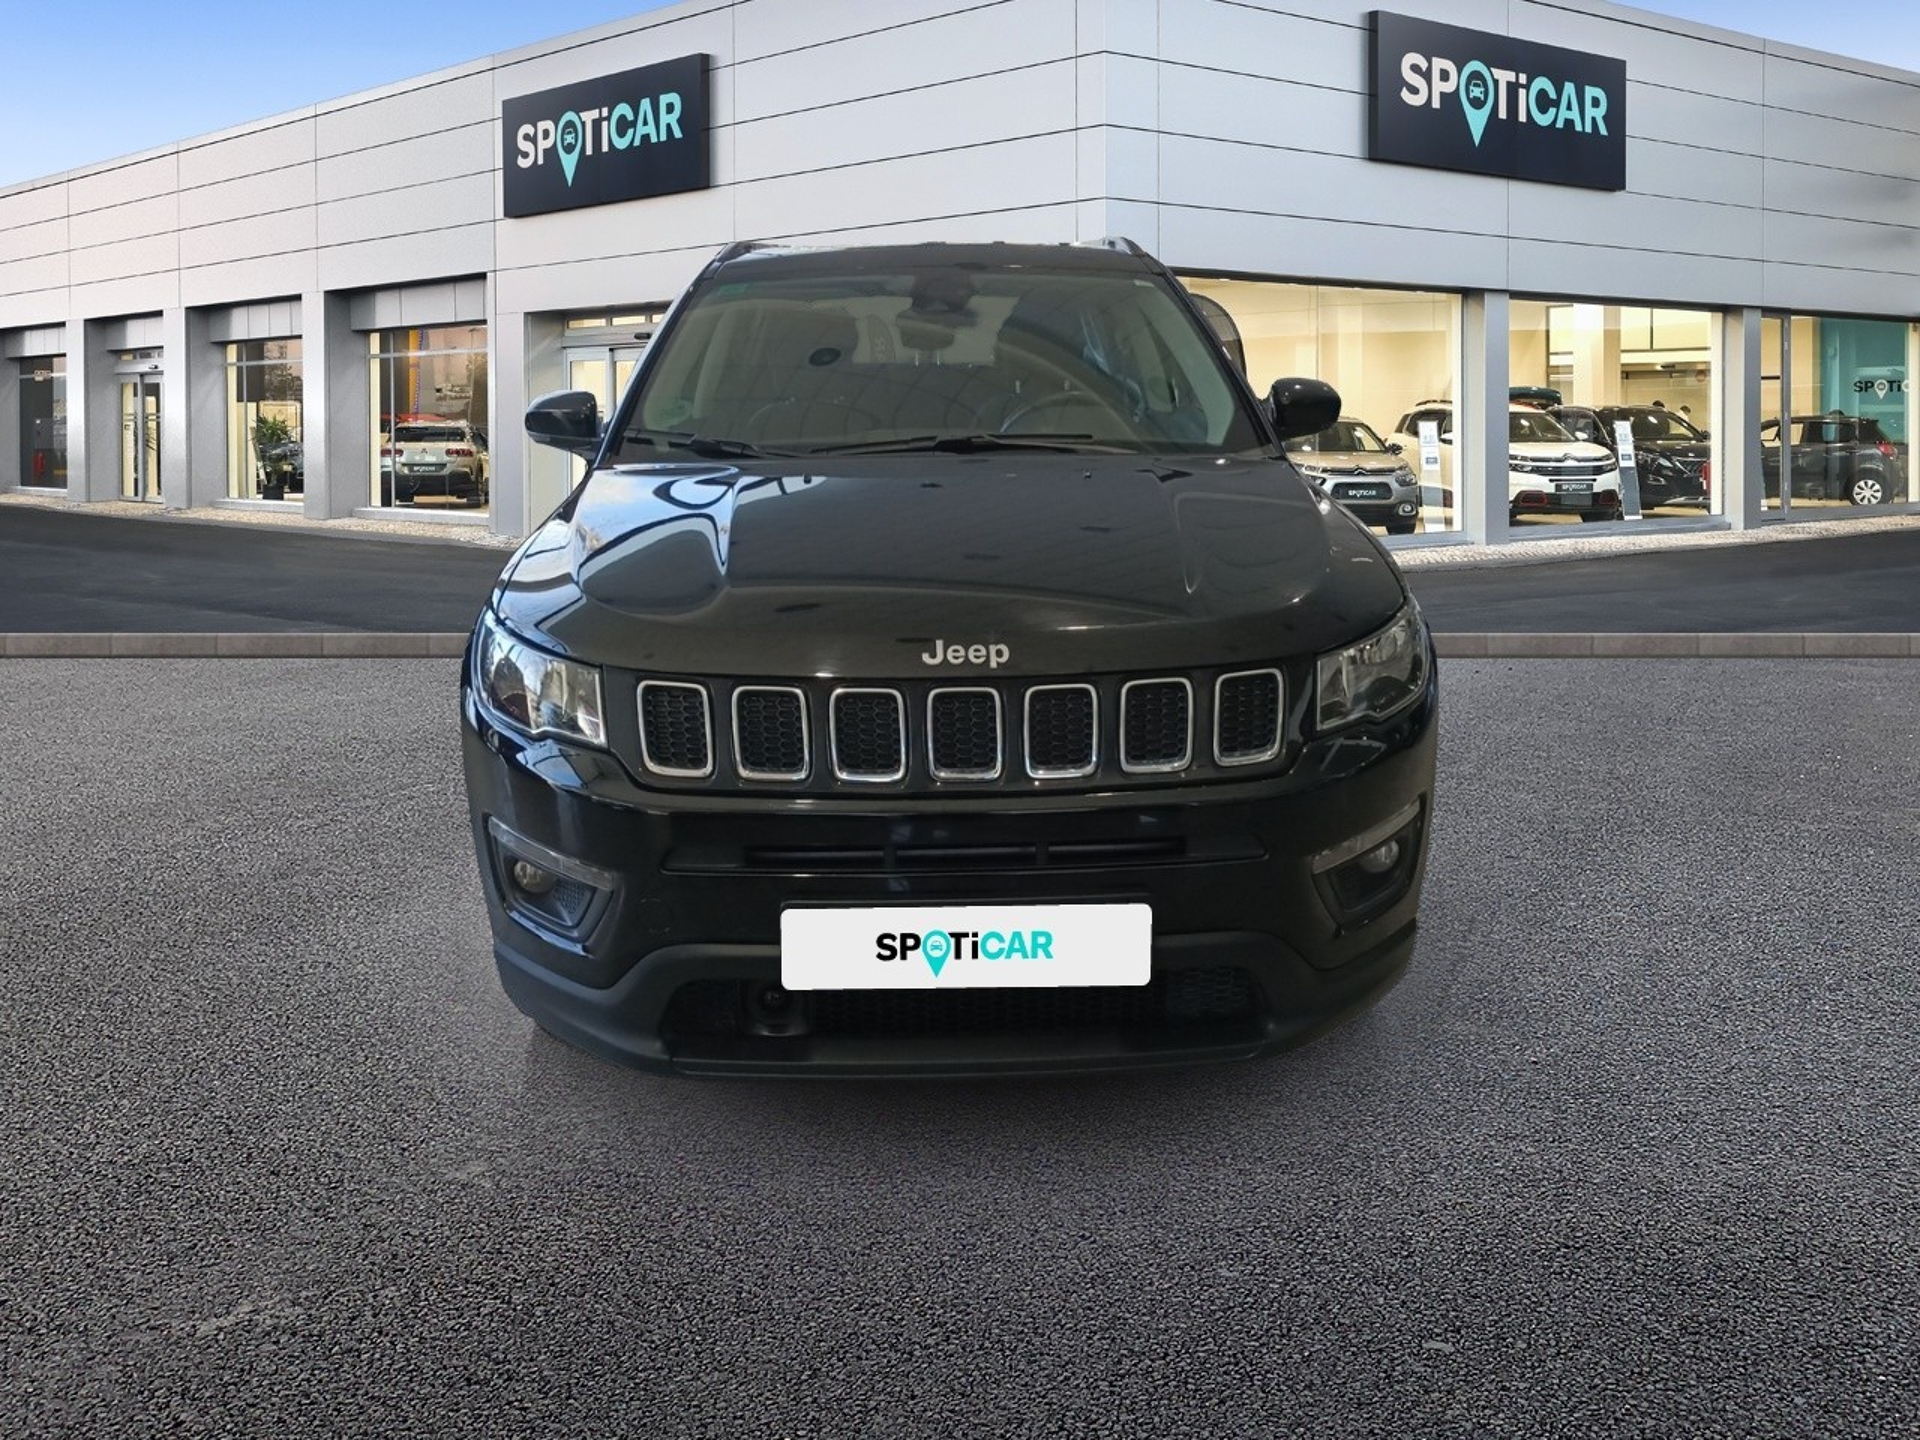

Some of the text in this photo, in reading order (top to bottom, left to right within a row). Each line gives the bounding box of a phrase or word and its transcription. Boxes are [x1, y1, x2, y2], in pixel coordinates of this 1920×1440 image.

[516, 92, 683, 187] SPOTiCAR
[1400, 52, 1609, 147] SPOTiCAR
[922, 640, 1010, 668] Jeep
